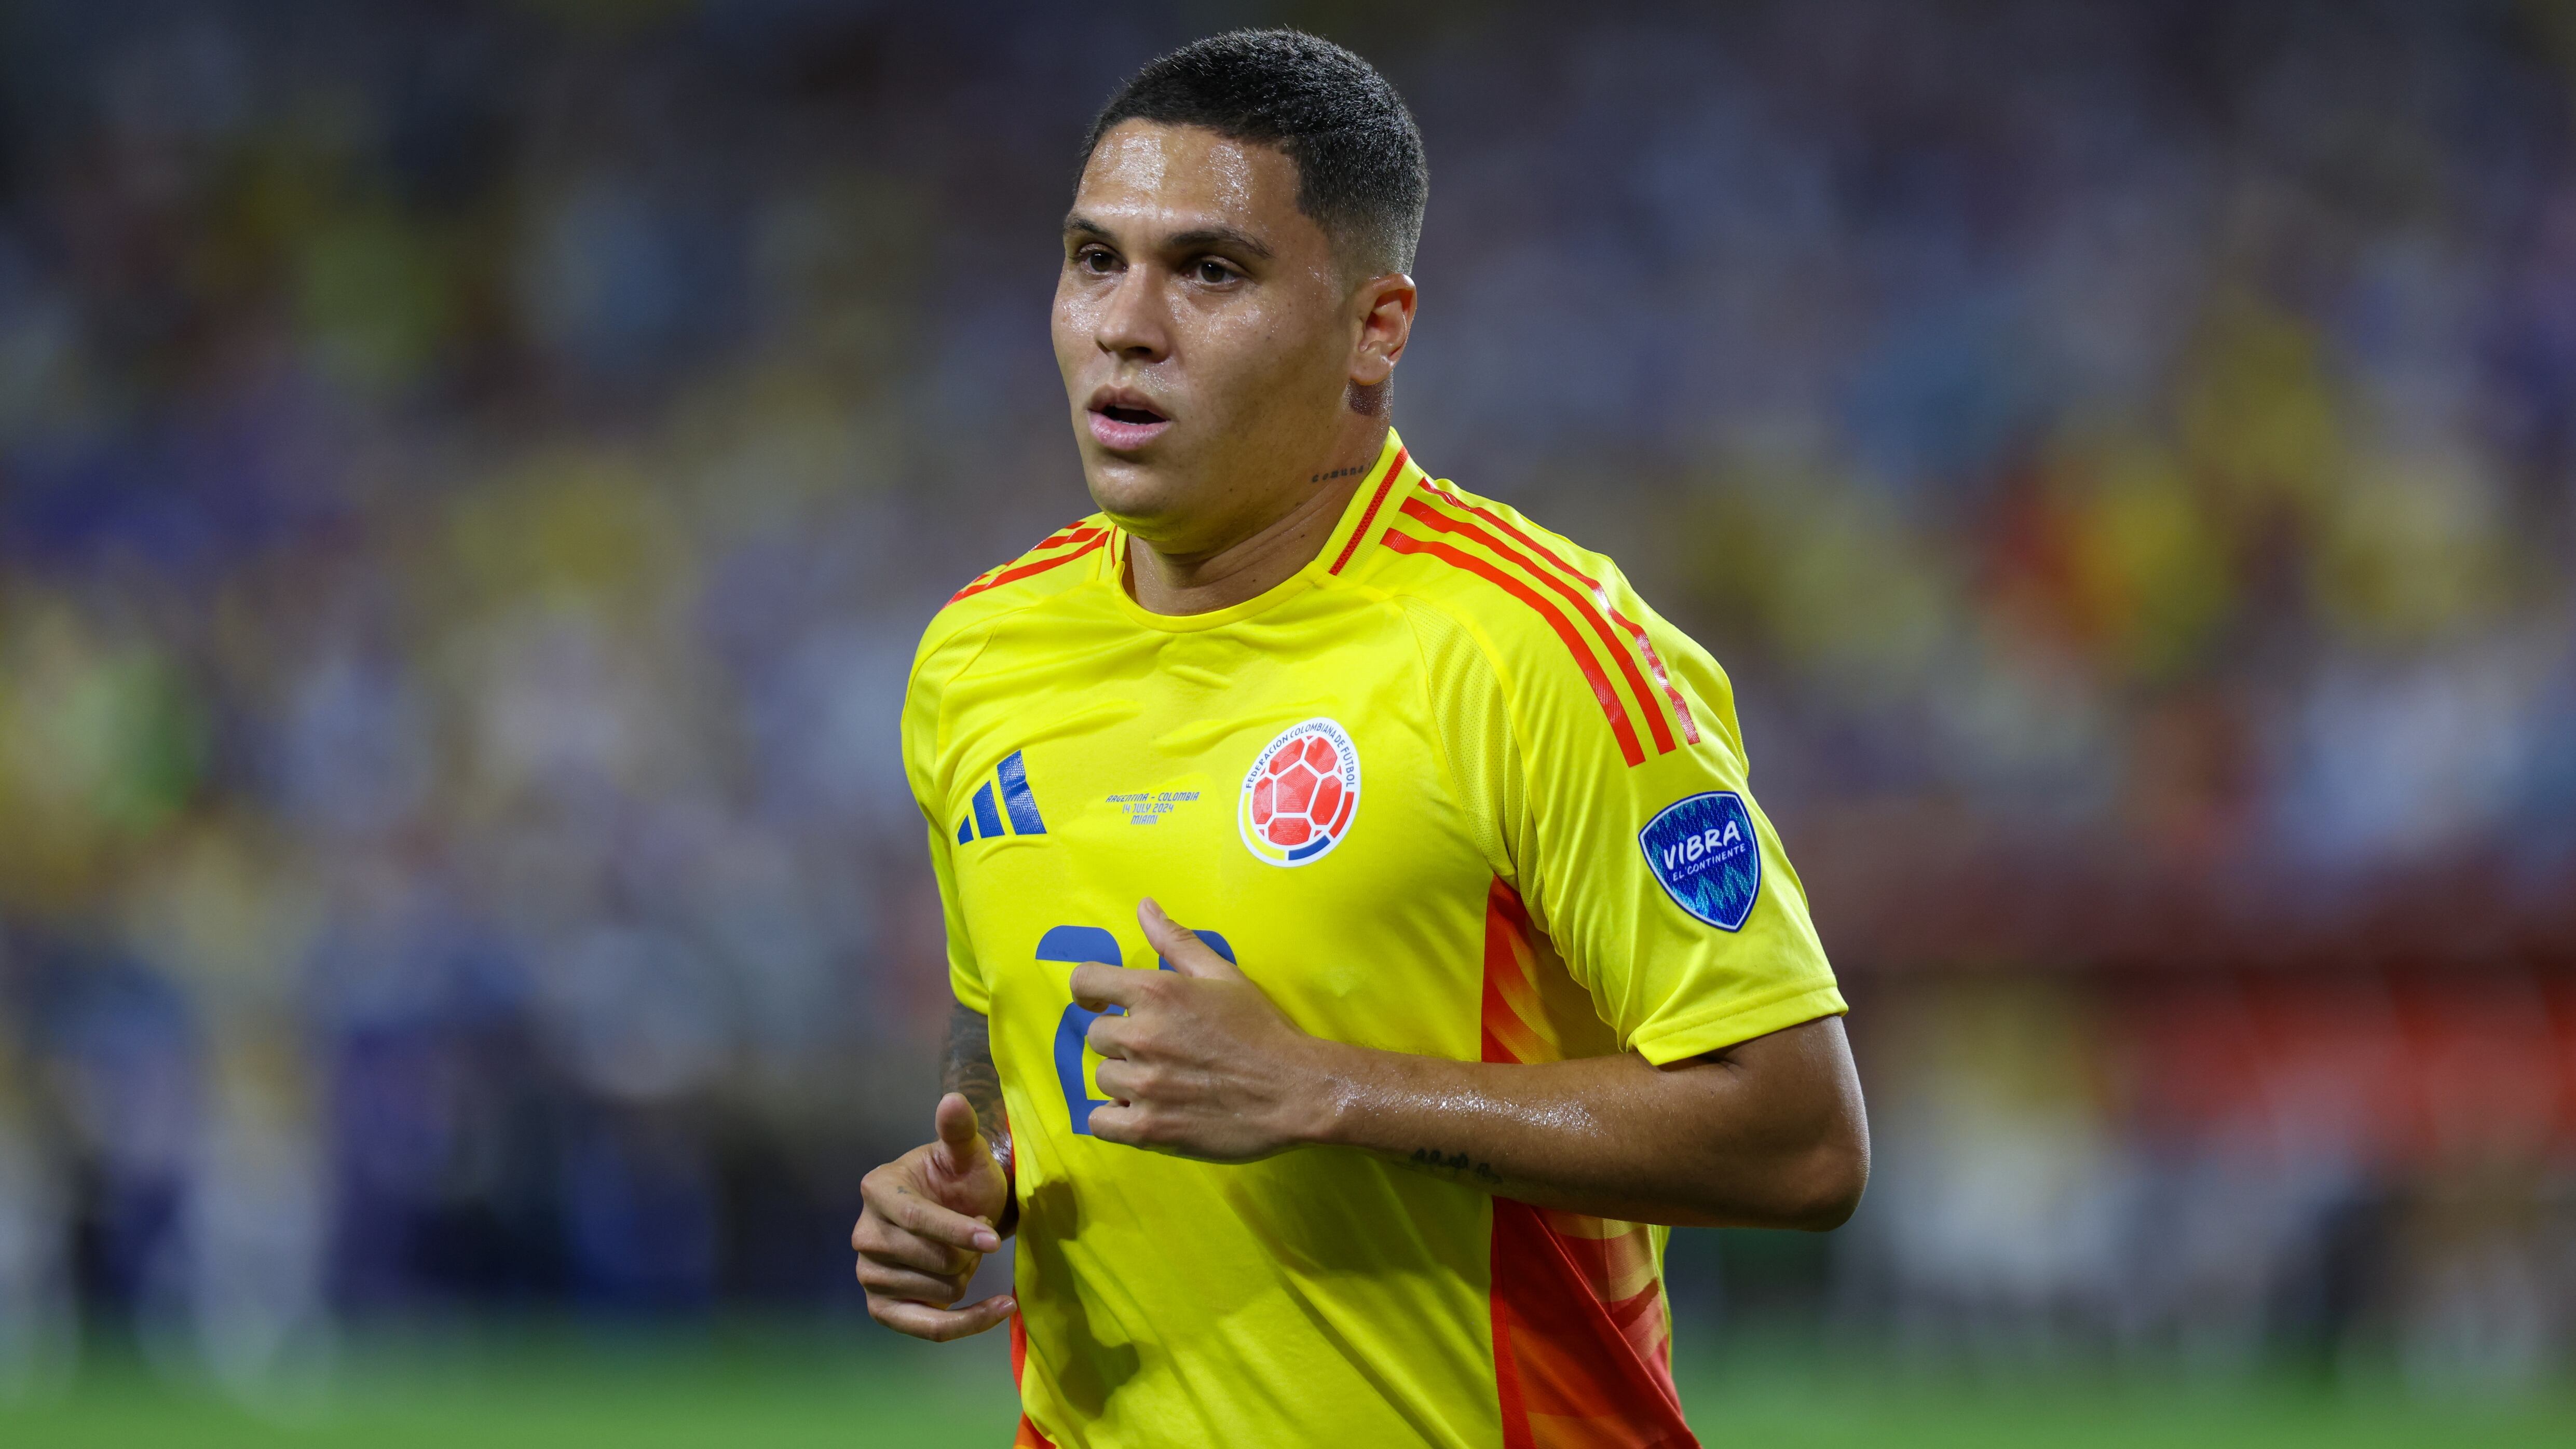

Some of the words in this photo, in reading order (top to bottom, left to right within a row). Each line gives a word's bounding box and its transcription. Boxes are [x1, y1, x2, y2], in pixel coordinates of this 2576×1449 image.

[1246, 734, 1288, 788] FEDERACIÓN
[1290, 722, 1336, 738] COLOMBIANA
[1334, 734, 1345, 748] DE
[1341, 746, 1355, 787] FÚTBOL
[1106, 793, 1149, 802] ARGENTINA
[1158, 792, 1200, 801] COLOMBIA
[1122, 804, 1130, 814] 14
[1133, 803, 1151, 814] JULY
[1152, 803, 1174, 813] 2024
[1130, 815, 1158, 825] MIAMI
[1664, 820, 1741, 870] VIBRA
[1673, 870, 1684, 881] EL
[1687, 843, 1746, 875] CONTINENTE
